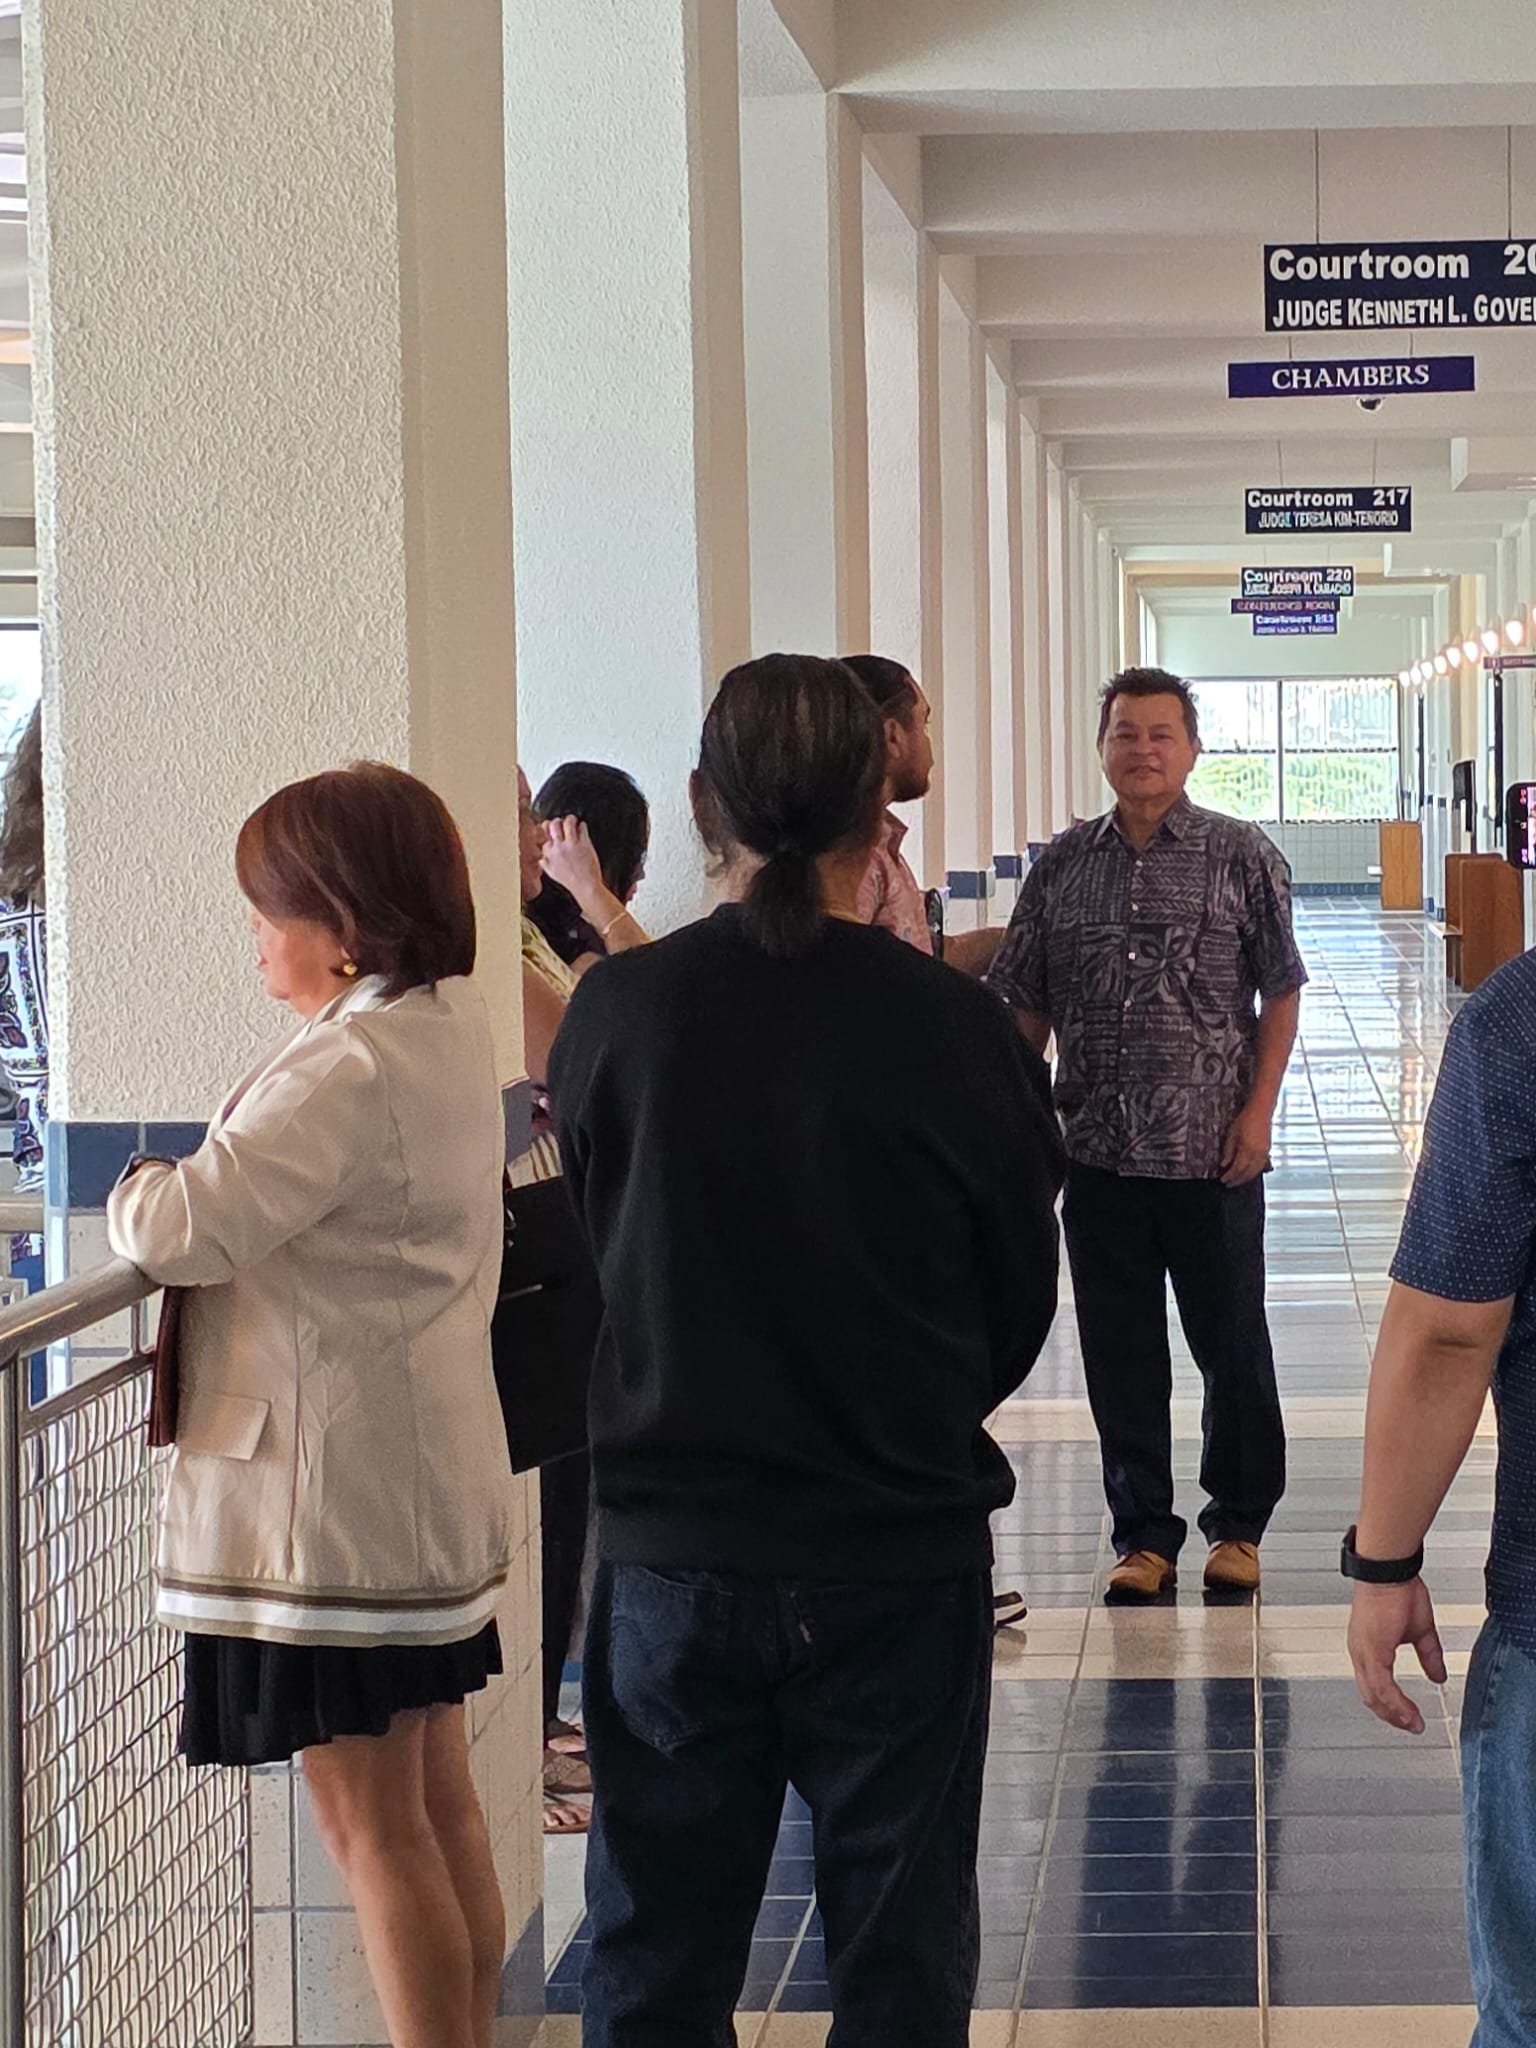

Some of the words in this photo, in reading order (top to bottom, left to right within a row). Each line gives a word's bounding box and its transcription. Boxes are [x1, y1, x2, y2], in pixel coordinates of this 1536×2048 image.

[1269, 248, 1470, 281] Courtroom
[1272, 298, 1343, 328] JUDGE
[1348, 296, 1444, 326] KENNETH
[1448, 295, 1468, 324] L.
[1473, 293, 1536, 323] GOVE
[1271, 364, 1430, 390] CHAMBERS
[1247, 490, 1354, 508] Courtroom
[1373, 488, 1409, 506] 217
[1243, 569, 1323, 583] Courtroom
[1326, 568, 1352, 582] 220
